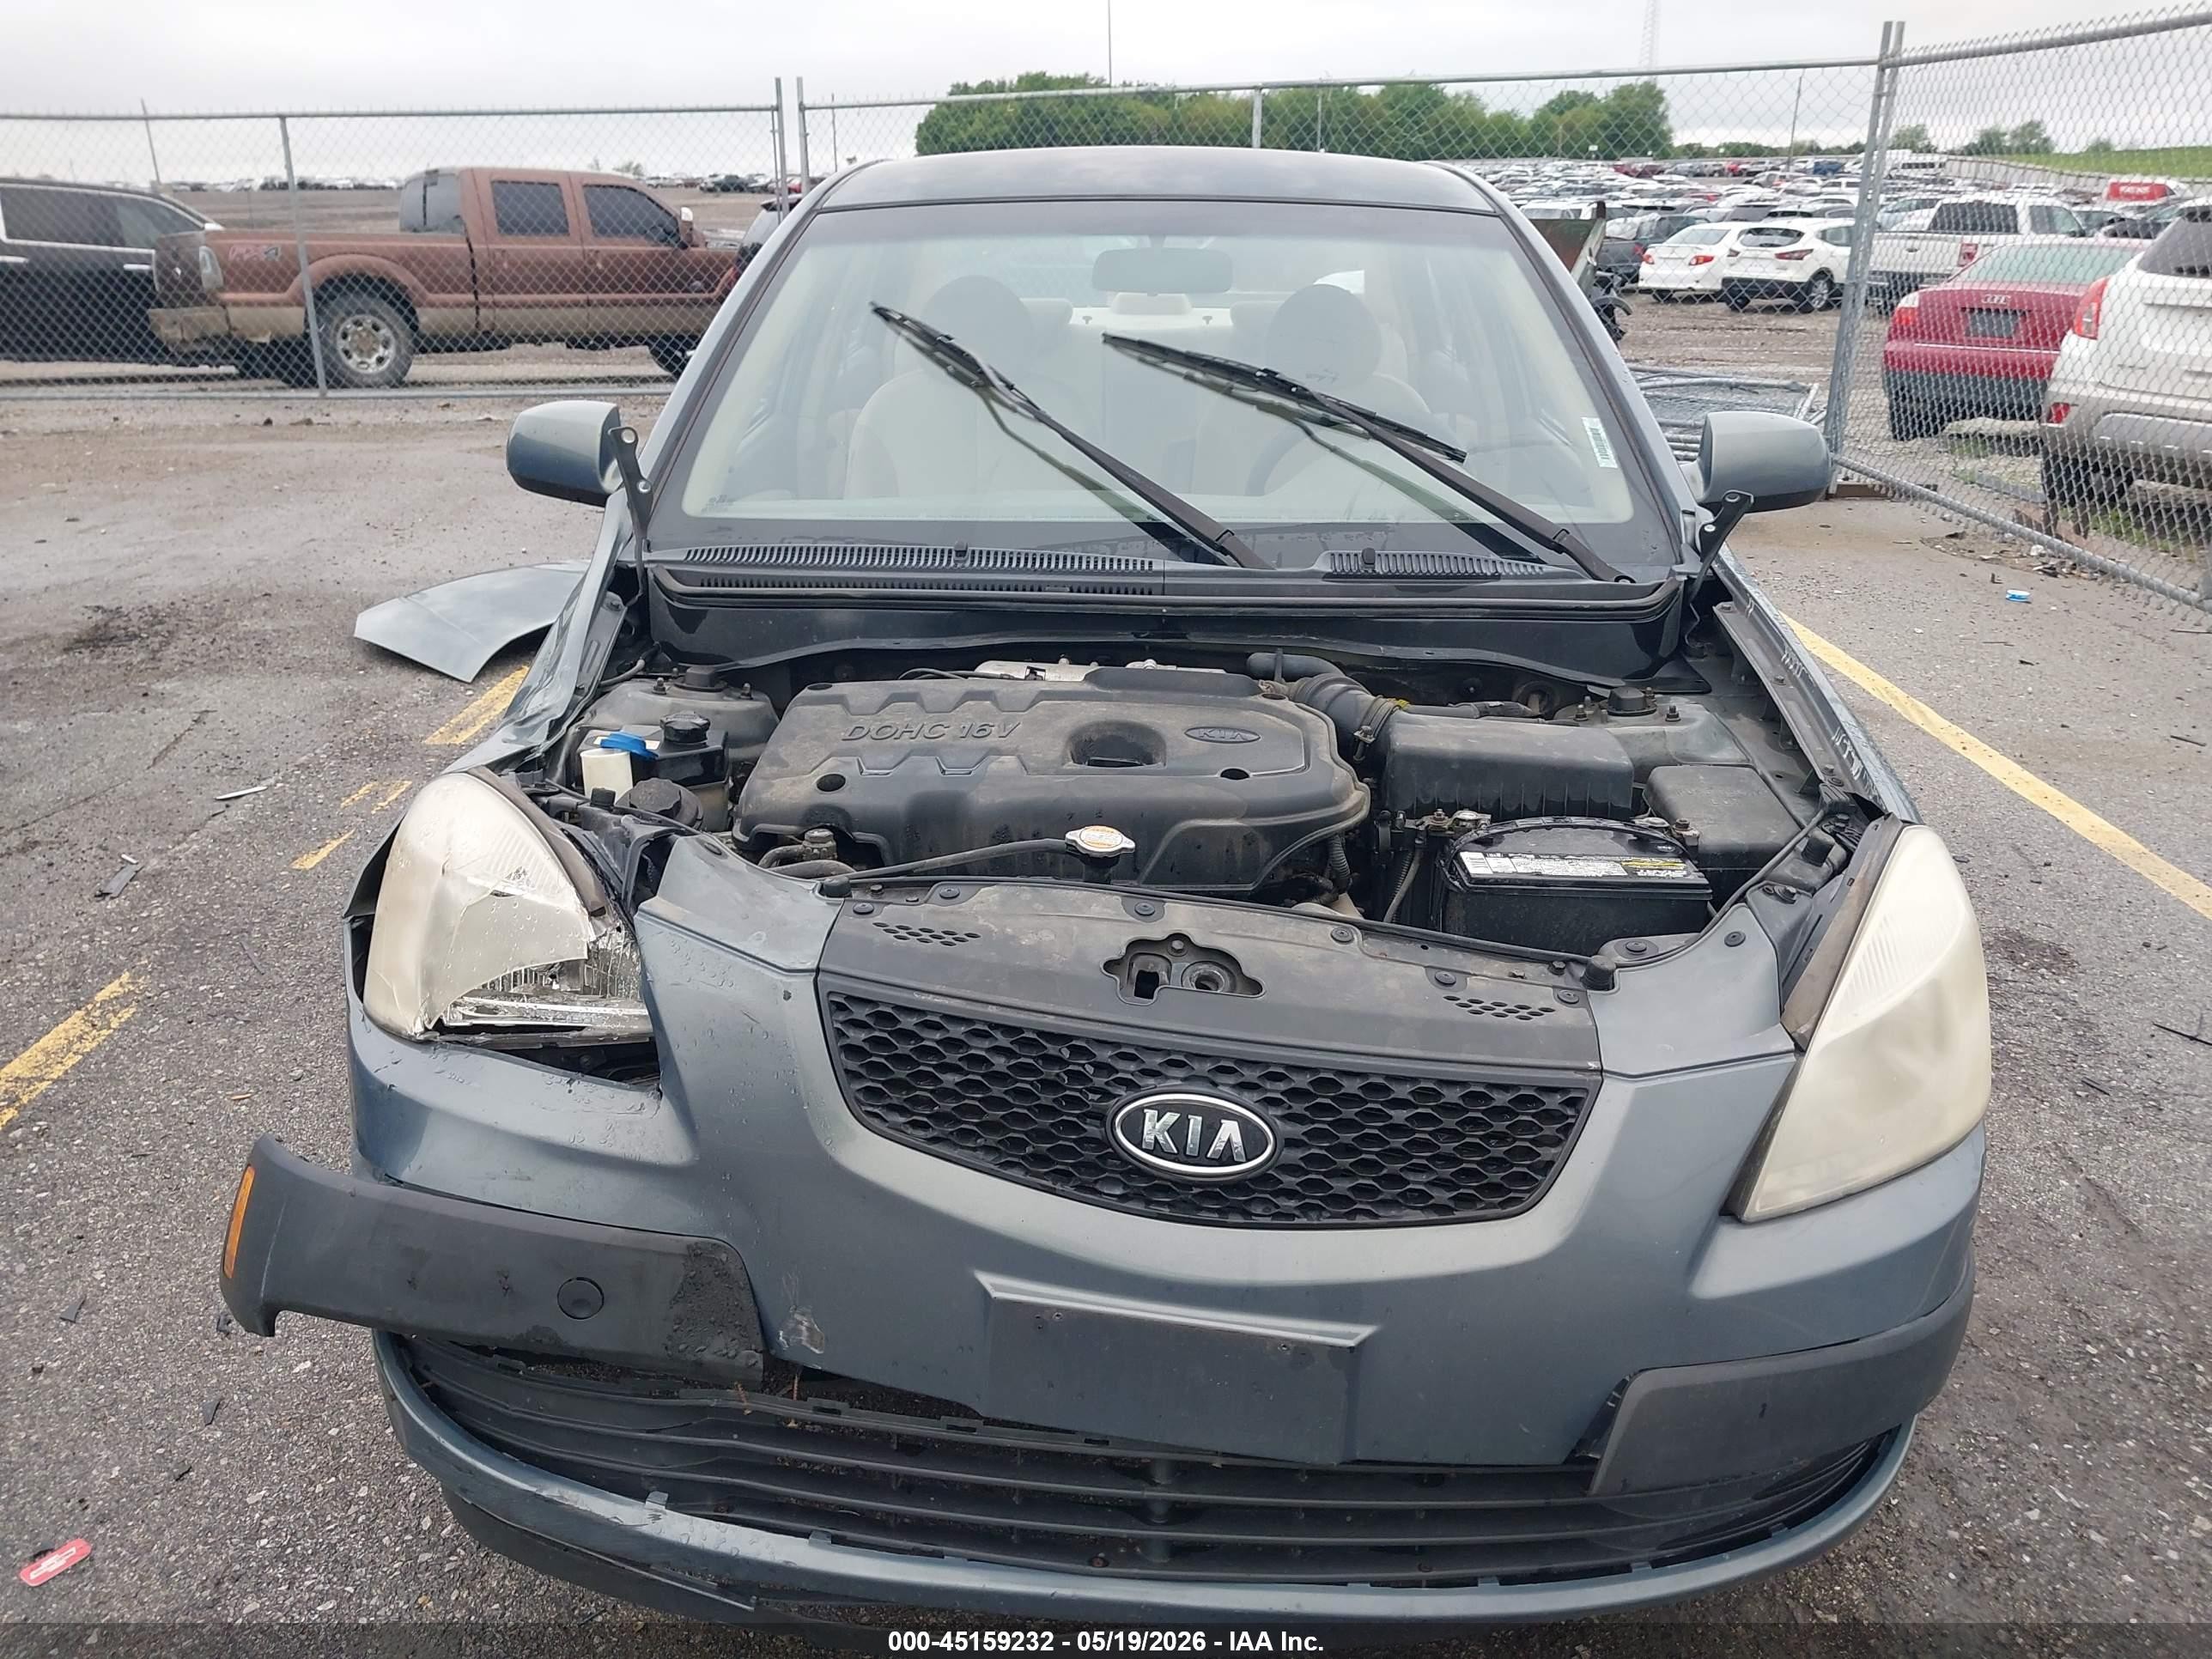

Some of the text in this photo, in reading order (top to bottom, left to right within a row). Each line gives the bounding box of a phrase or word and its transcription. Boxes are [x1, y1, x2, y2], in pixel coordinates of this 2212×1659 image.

[842, 721, 1022, 742] DOHC 16V
[1197, 727, 1250, 741] KIA
[1141, 1109, 1247, 1163] KIA
